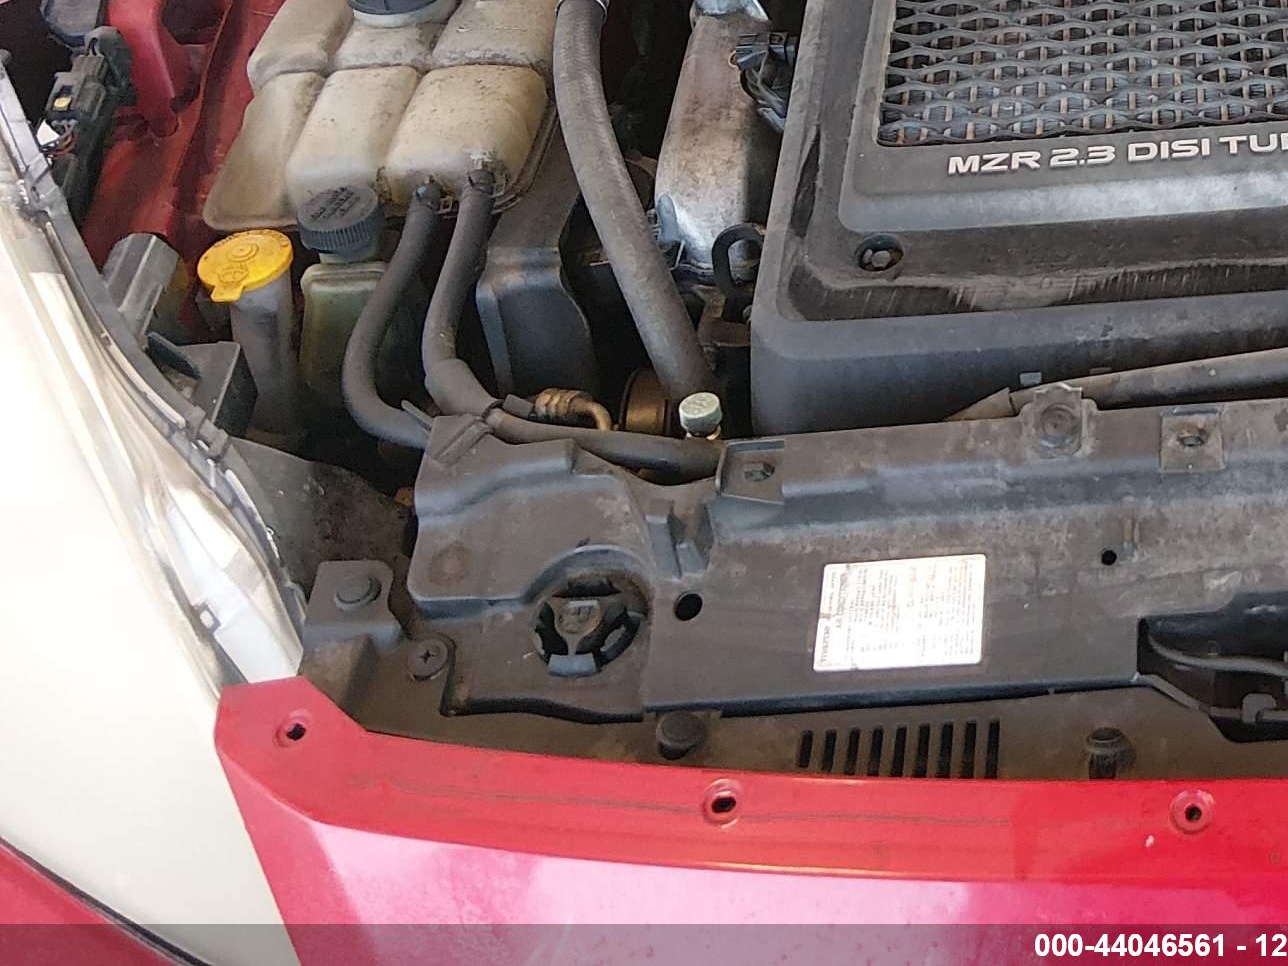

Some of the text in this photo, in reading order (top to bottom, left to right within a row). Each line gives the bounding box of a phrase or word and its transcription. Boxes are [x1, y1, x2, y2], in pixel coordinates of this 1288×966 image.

[947, 150, 1041, 175] MZR
[1048, 145, 1117, 169] 2.3
[1126, 137, 1212, 163] DISI
